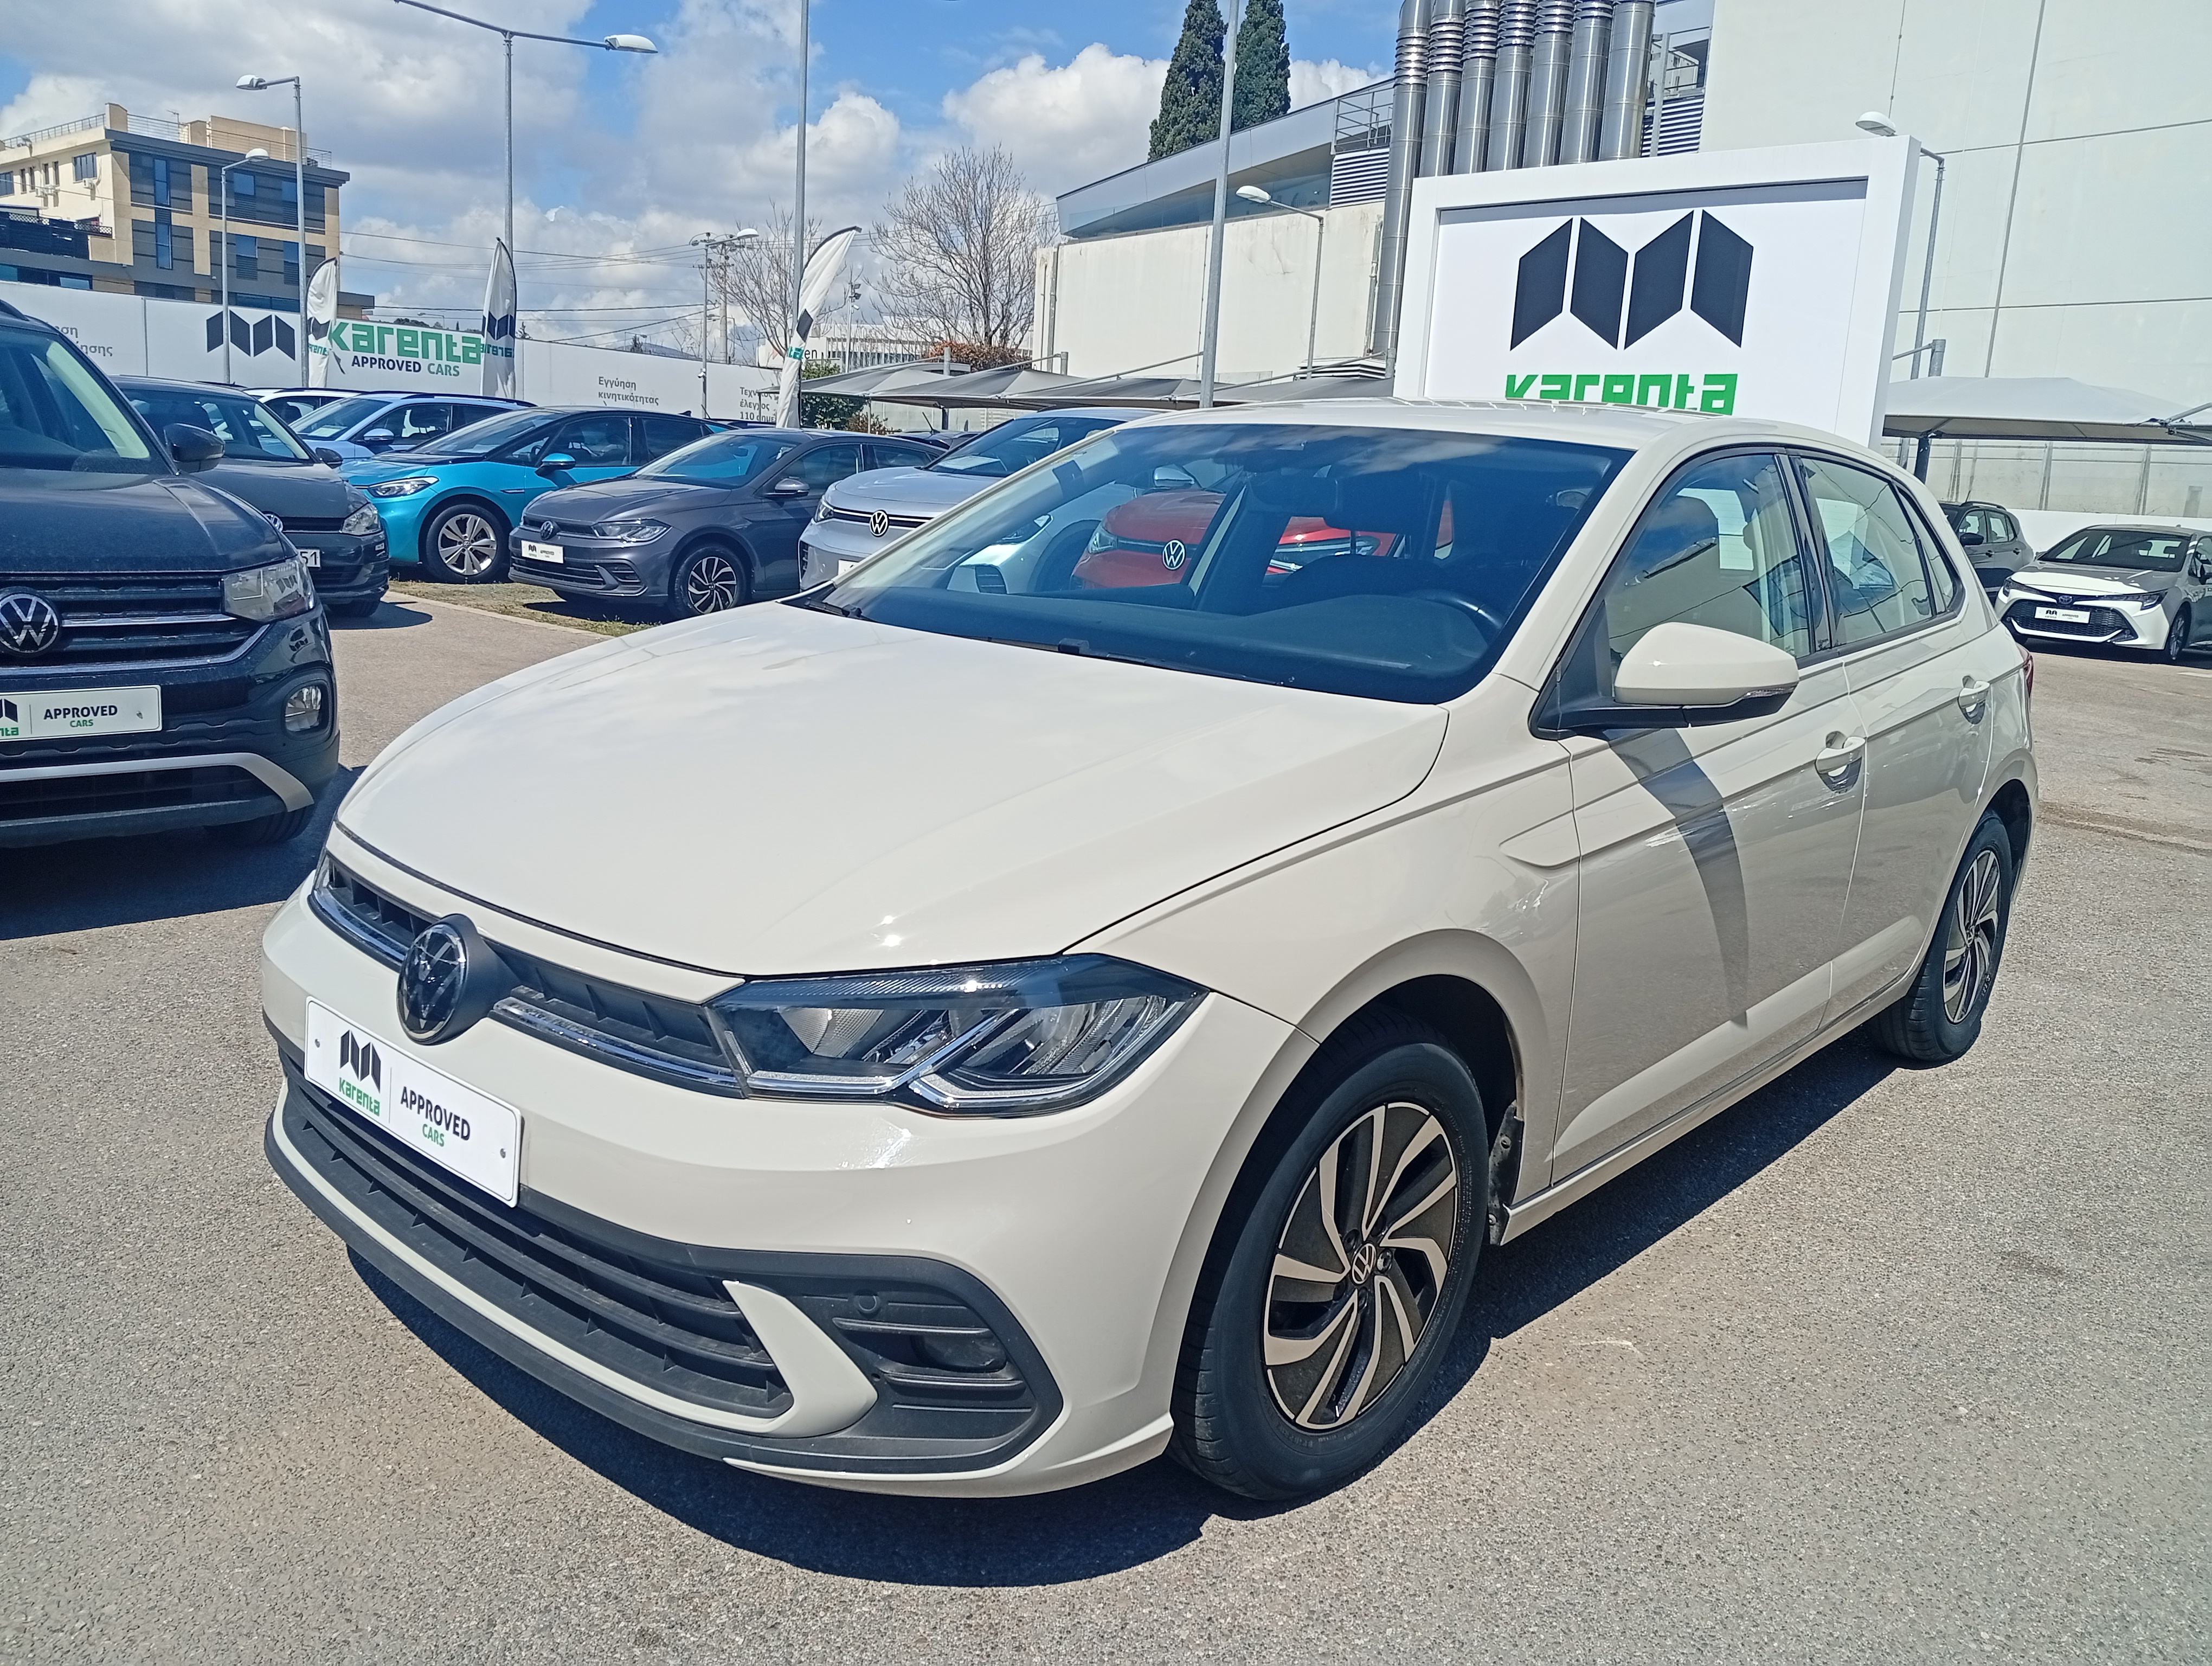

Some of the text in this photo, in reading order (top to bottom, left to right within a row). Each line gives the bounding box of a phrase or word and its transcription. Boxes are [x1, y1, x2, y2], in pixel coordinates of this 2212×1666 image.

[351, 355, 460, 377] APPROVED CARS
[598, 376, 636, 391] Εγγύηση
[598, 392, 659, 406] κινητικότητας
[740, 412, 755, 420] 110
[43, 705, 118, 720] APPROVED
[69, 719, 94, 728] CARS
[401, 1086, 471, 1140] APPROVED
[422, 1124, 445, 1147] CARS
